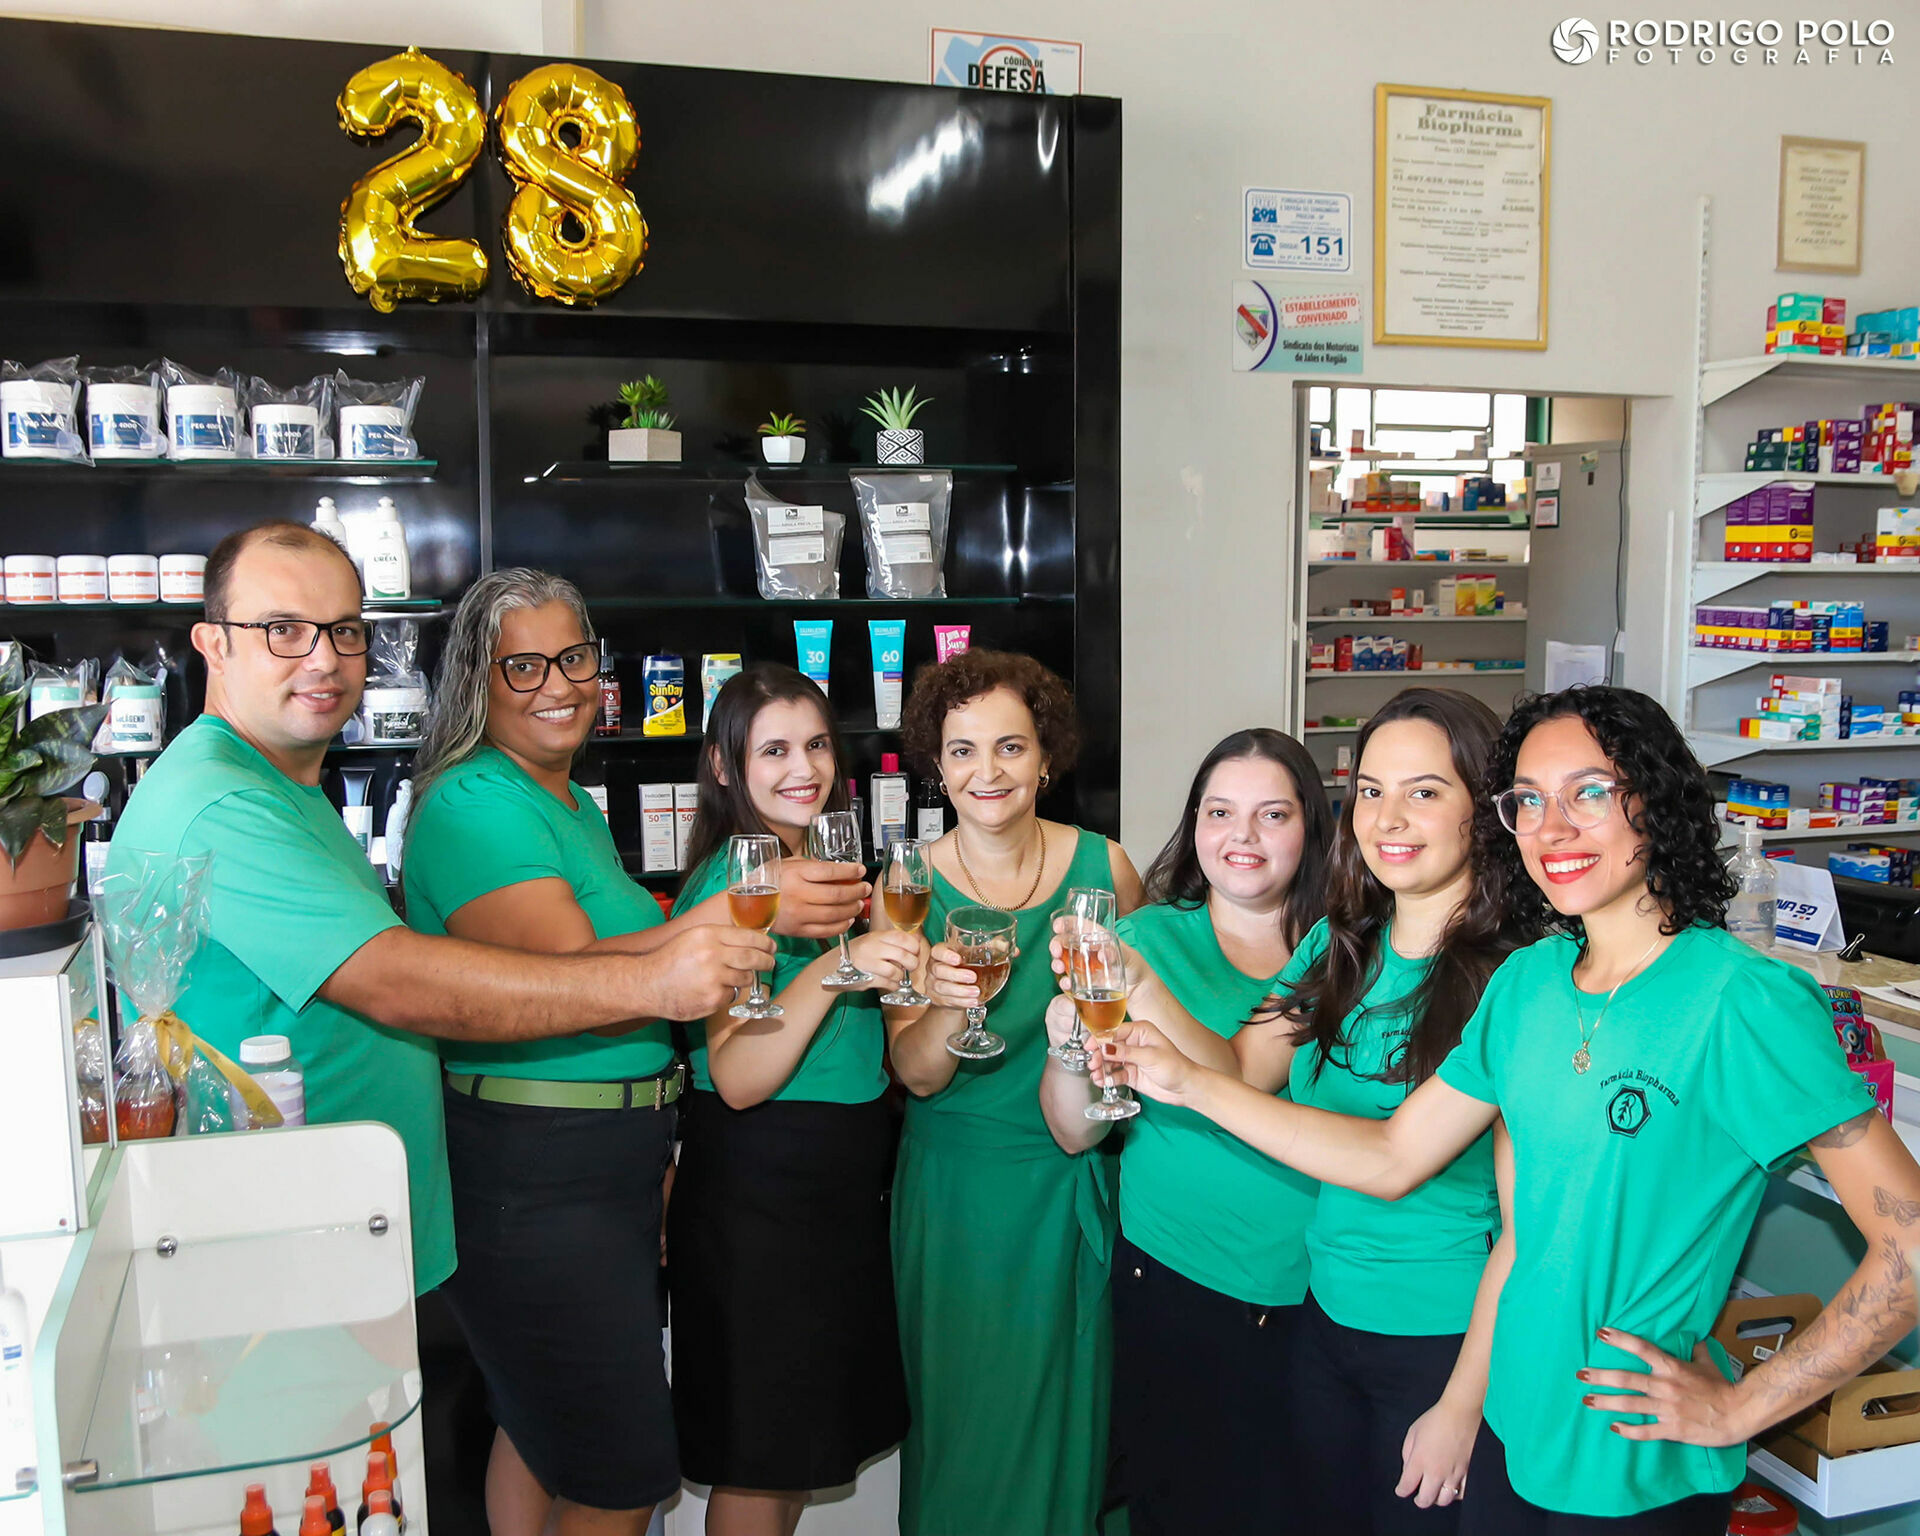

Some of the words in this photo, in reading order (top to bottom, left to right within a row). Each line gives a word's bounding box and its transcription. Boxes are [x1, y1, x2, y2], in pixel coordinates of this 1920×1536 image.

[1004, 56, 1033, 67] CÓDIGO
[1034, 59, 1044, 68] DE
[968, 63, 1046, 93] DEFESA
[1424, 104, 1514, 123] Farmácia
[1417, 117, 1523, 137] Biopharma
[1300, 235, 1343, 256] 151
[1285, 298, 1357, 312] ESTABELECIMENTO
[1296, 311, 1348, 324] CONVENIADO
[1283, 340, 1313, 350] Sindicato
[1313, 341, 1325, 351] dos
[1326, 342, 1359, 352] Motoristas
[1295, 353, 1303, 362] de
[1304, 354, 1319, 363] Jales
[1326, 354, 1347, 365] Região
[190, 422, 205, 430] PEG
[806, 651, 825, 664] 30
[882, 650, 900, 663] 60
[650, 684, 684, 698] SunDay
[648, 814, 660, 822] 50
[681, 813, 693, 822] 50
[1796, 903, 1818, 915] SD
[1600, 1068, 1633, 1089] Farmácia
[1635, 1069, 1680, 1106] Biopharma
